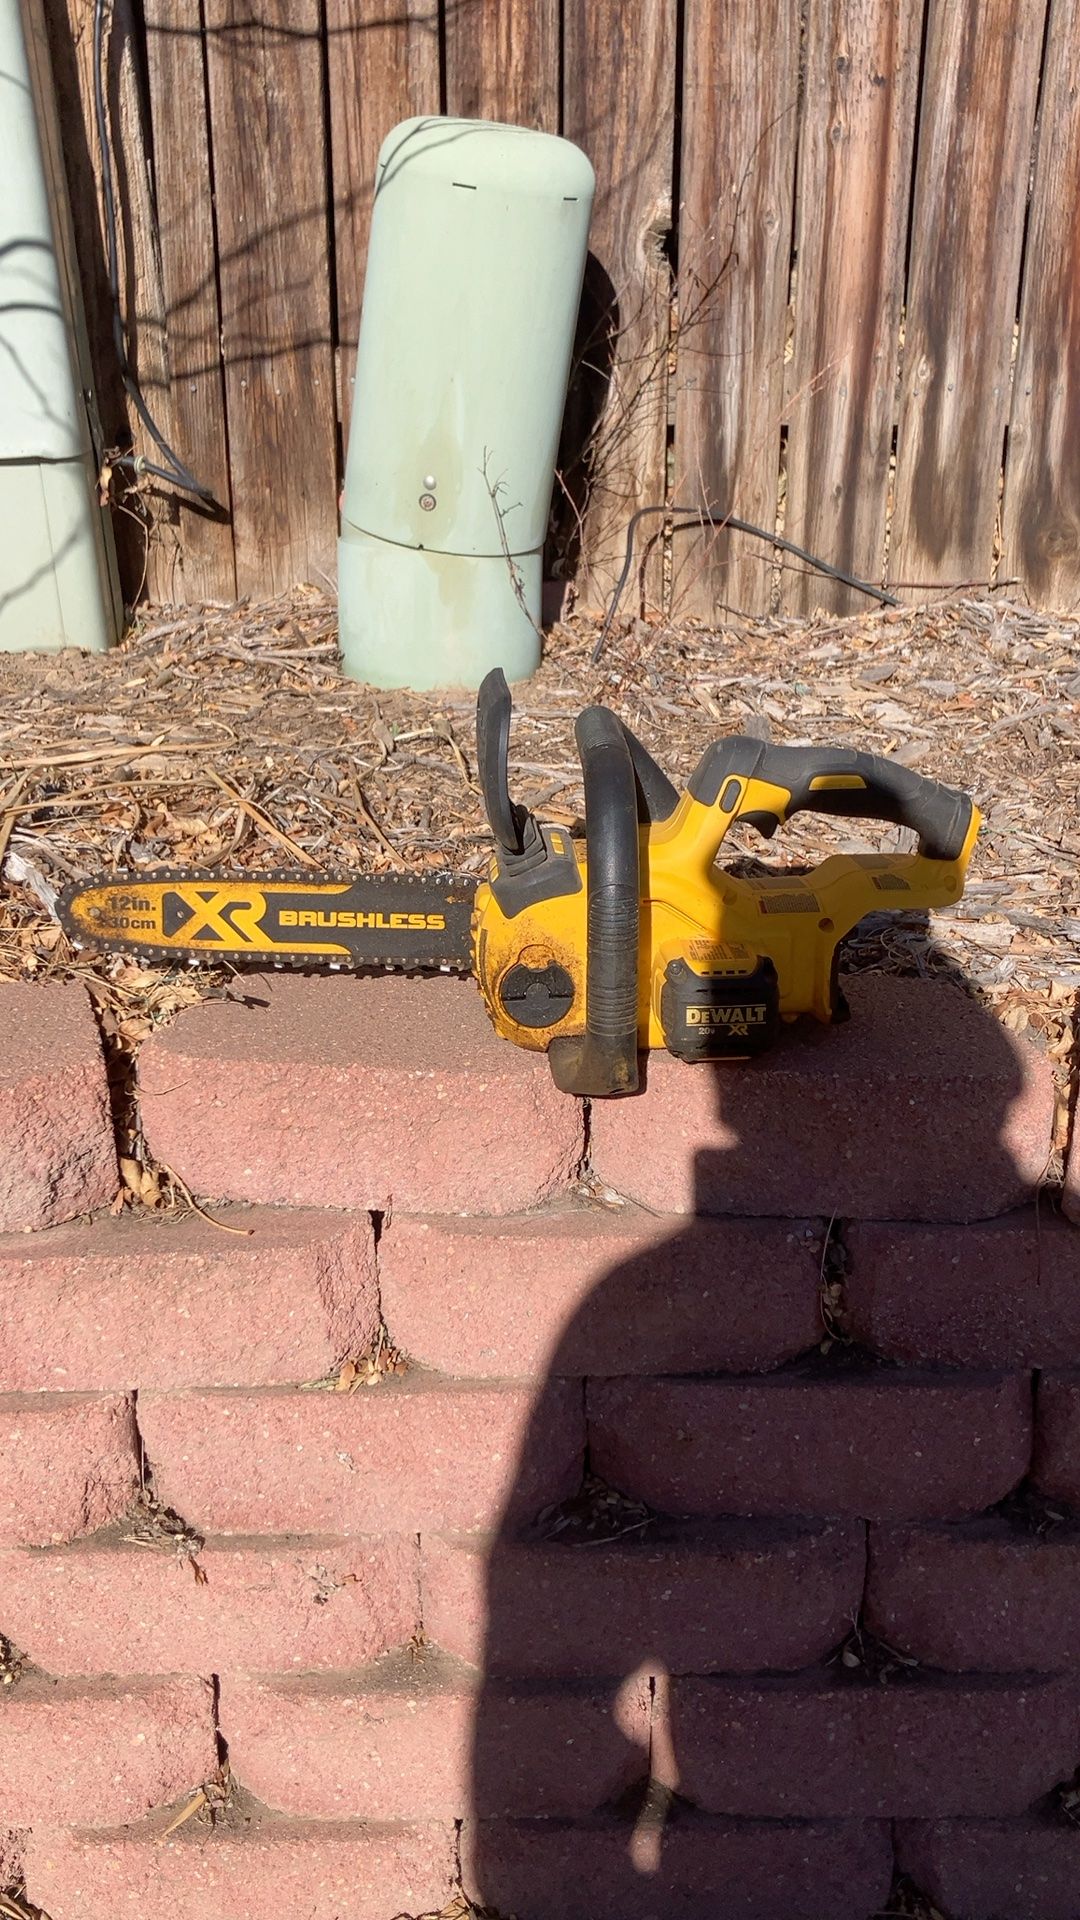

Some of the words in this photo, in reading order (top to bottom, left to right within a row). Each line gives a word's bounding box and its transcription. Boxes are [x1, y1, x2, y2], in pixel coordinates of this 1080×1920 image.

[110, 917, 156, 930] 30cm
[172, 889, 275, 944] XR
[278, 909, 446, 931] BRUSHLESS
[727, 1024, 749, 1036] XR
